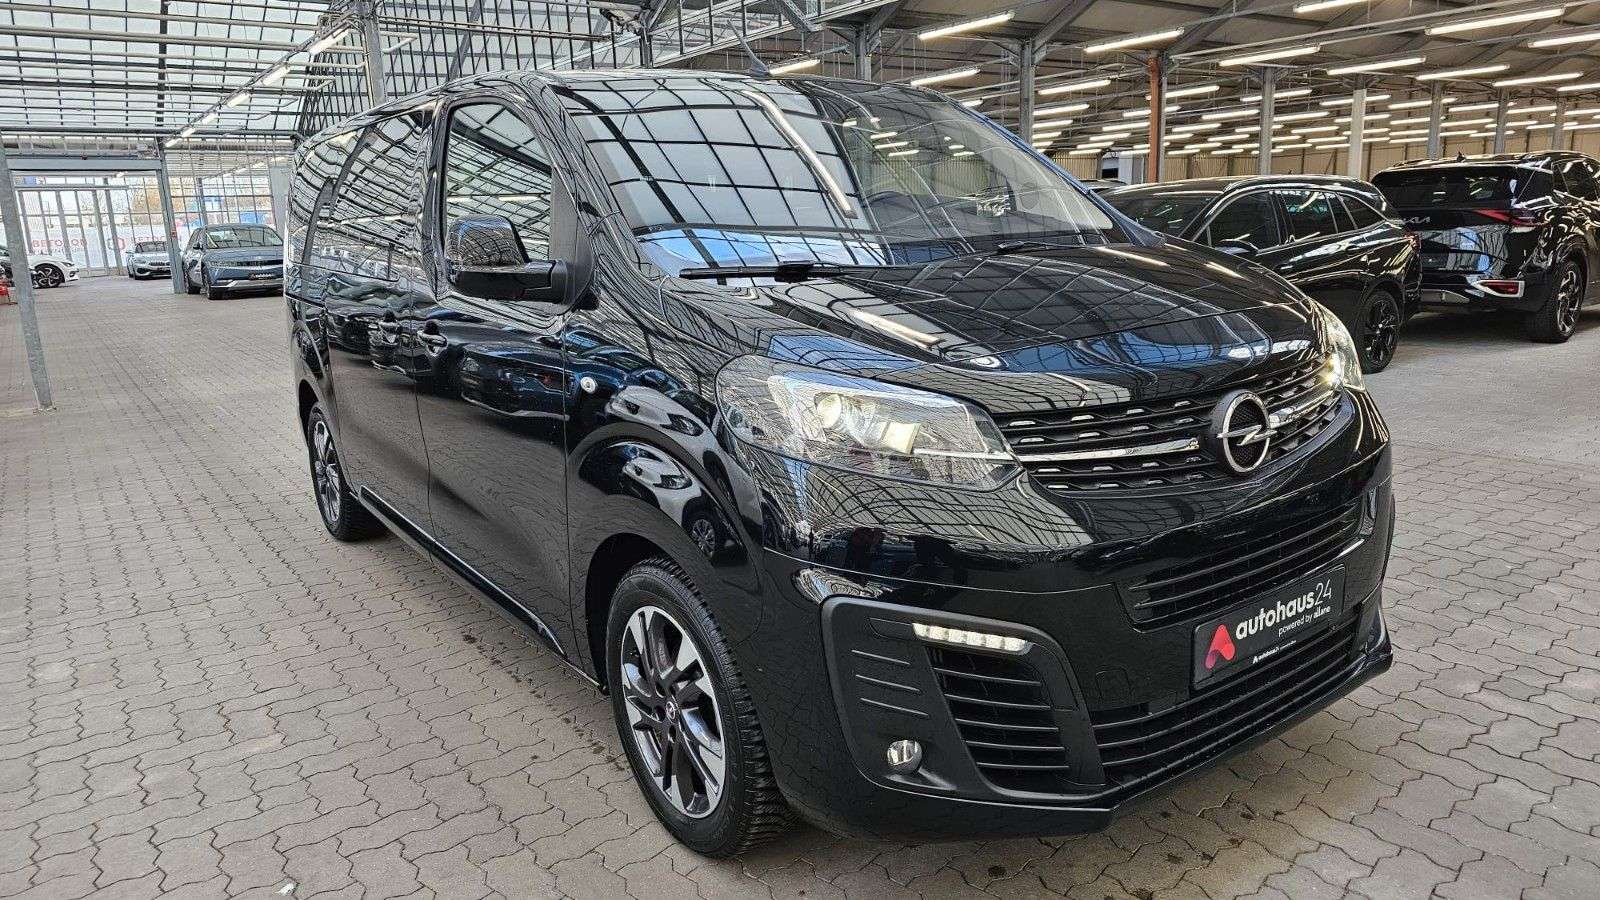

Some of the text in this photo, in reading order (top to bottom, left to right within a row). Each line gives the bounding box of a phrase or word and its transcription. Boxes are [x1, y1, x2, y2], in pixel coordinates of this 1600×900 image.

[1235, 579, 1332, 640] autohaus24
[1278, 614, 1305, 637] powered
[1305, 614, 1313, 623] by
